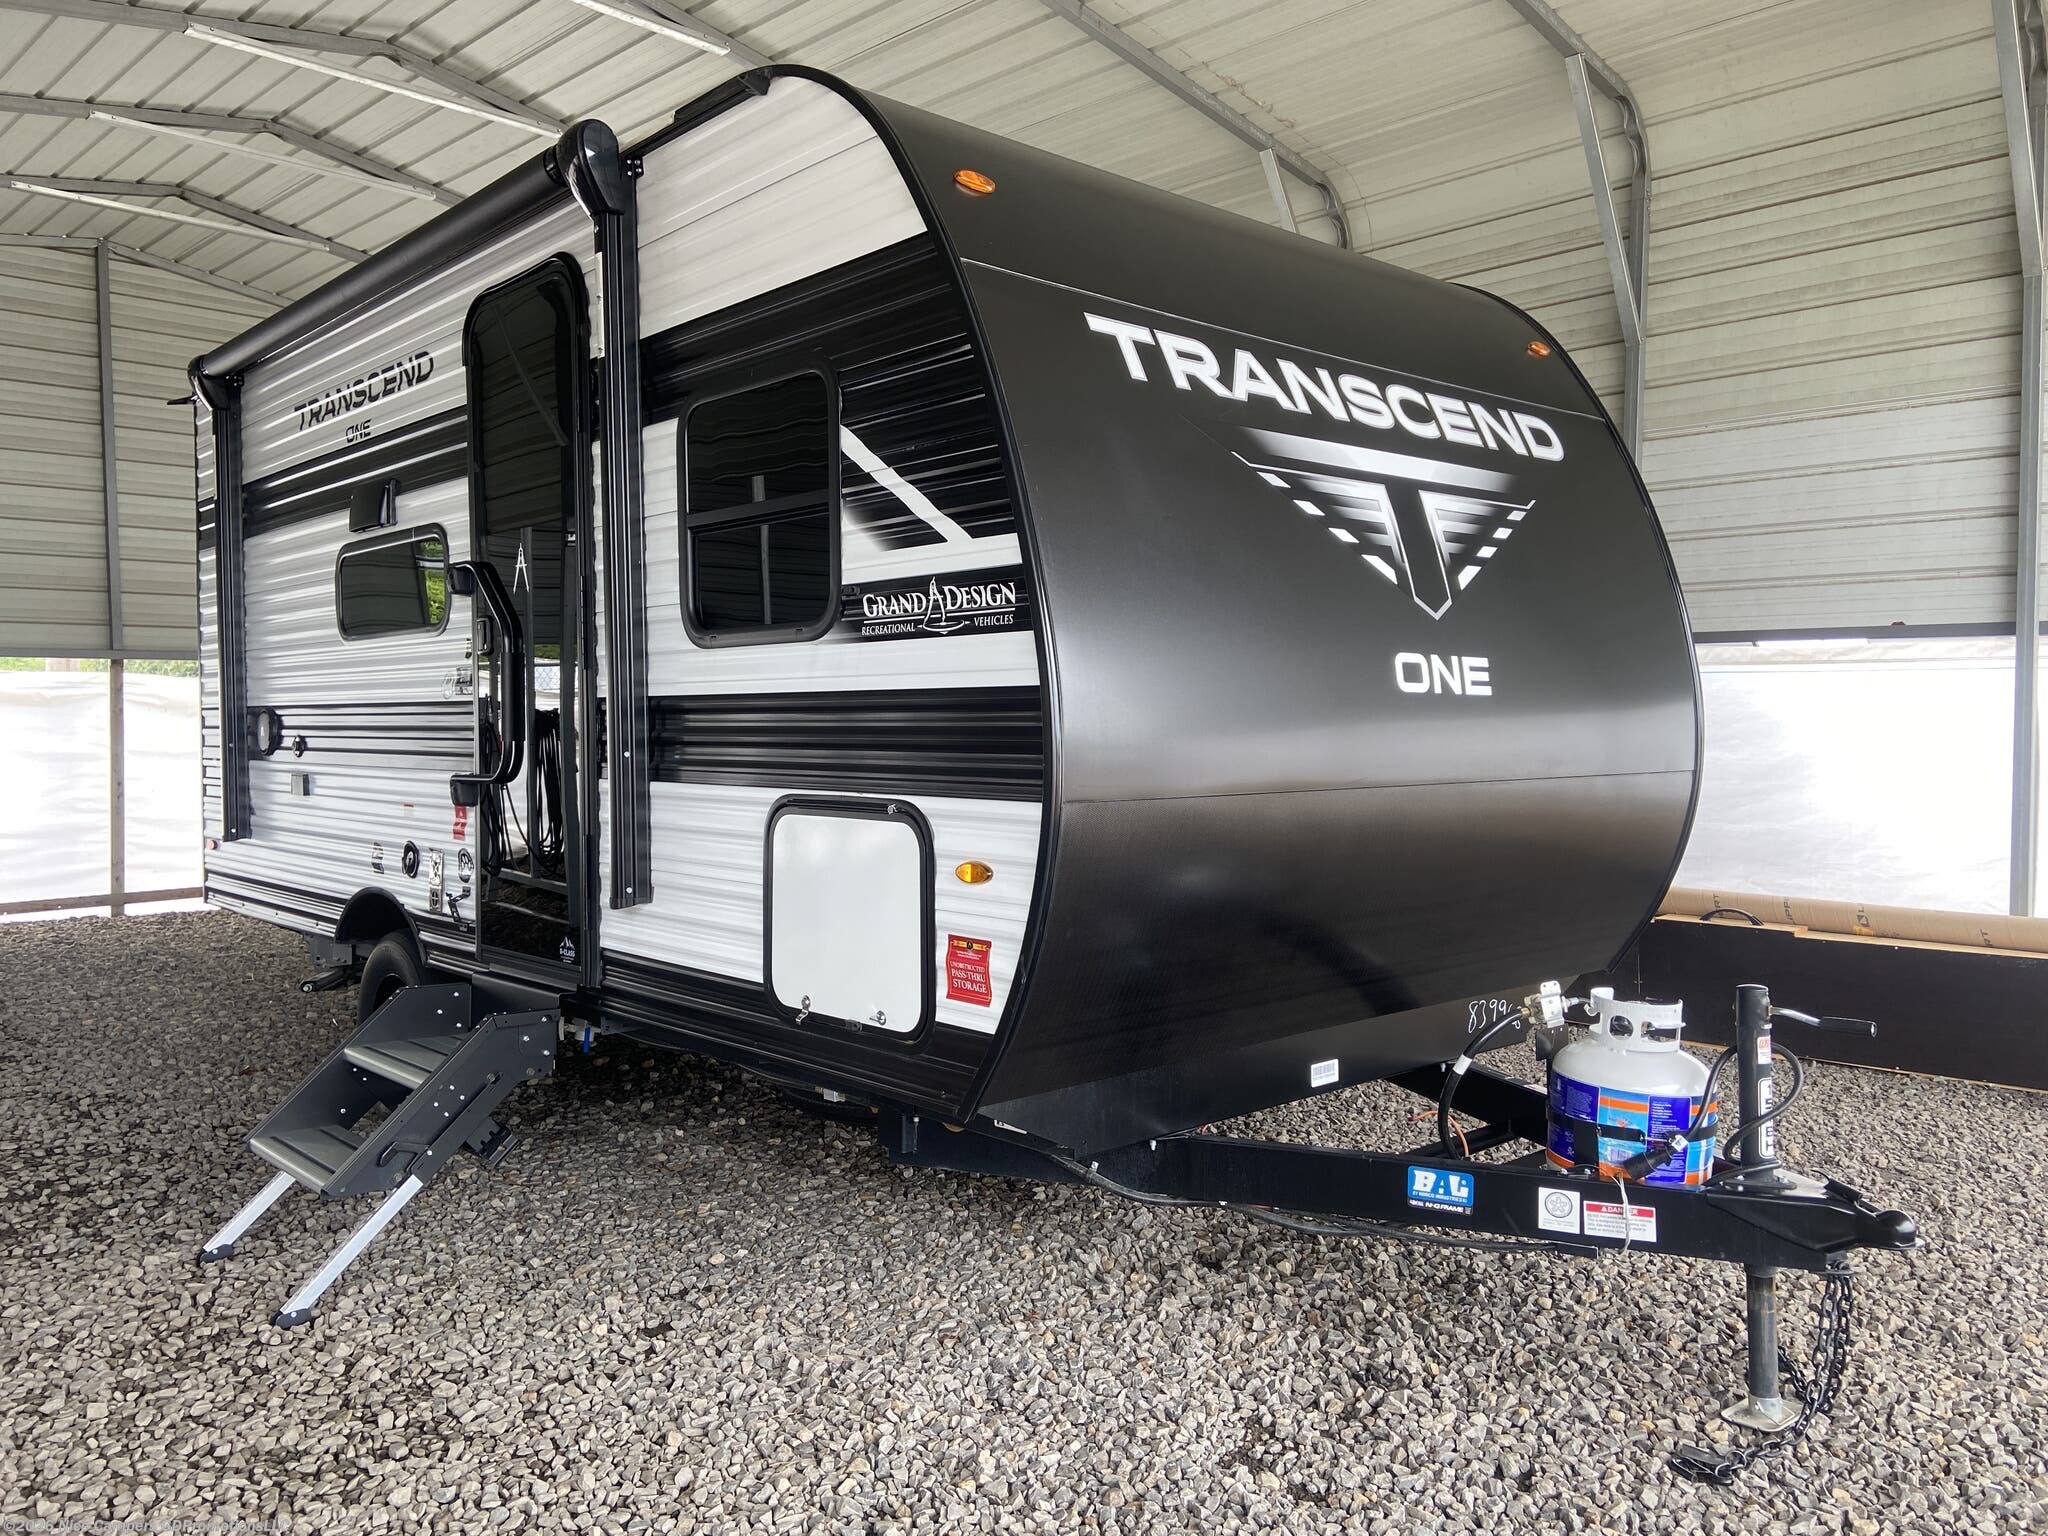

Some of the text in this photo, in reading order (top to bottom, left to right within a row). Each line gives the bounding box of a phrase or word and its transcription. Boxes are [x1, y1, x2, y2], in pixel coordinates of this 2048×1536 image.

[294, 351, 434, 431] TRANSCEND
[1083, 311, 1565, 462] TRANSCEND
[345, 420, 372, 443] ONE
[862, 582, 1016, 618] GRAND DESIGN
[861, 613, 1014, 636] RECREATIONAL VEHICLES
[1394, 651, 1493, 697] ONE
[950, 961, 986, 973] UNOBSTRUCTED
[953, 979, 987, 993] STORAGE
[1413, 1169, 1469, 1198] BAL
[1607, 1206, 1639, 1216] DANER
